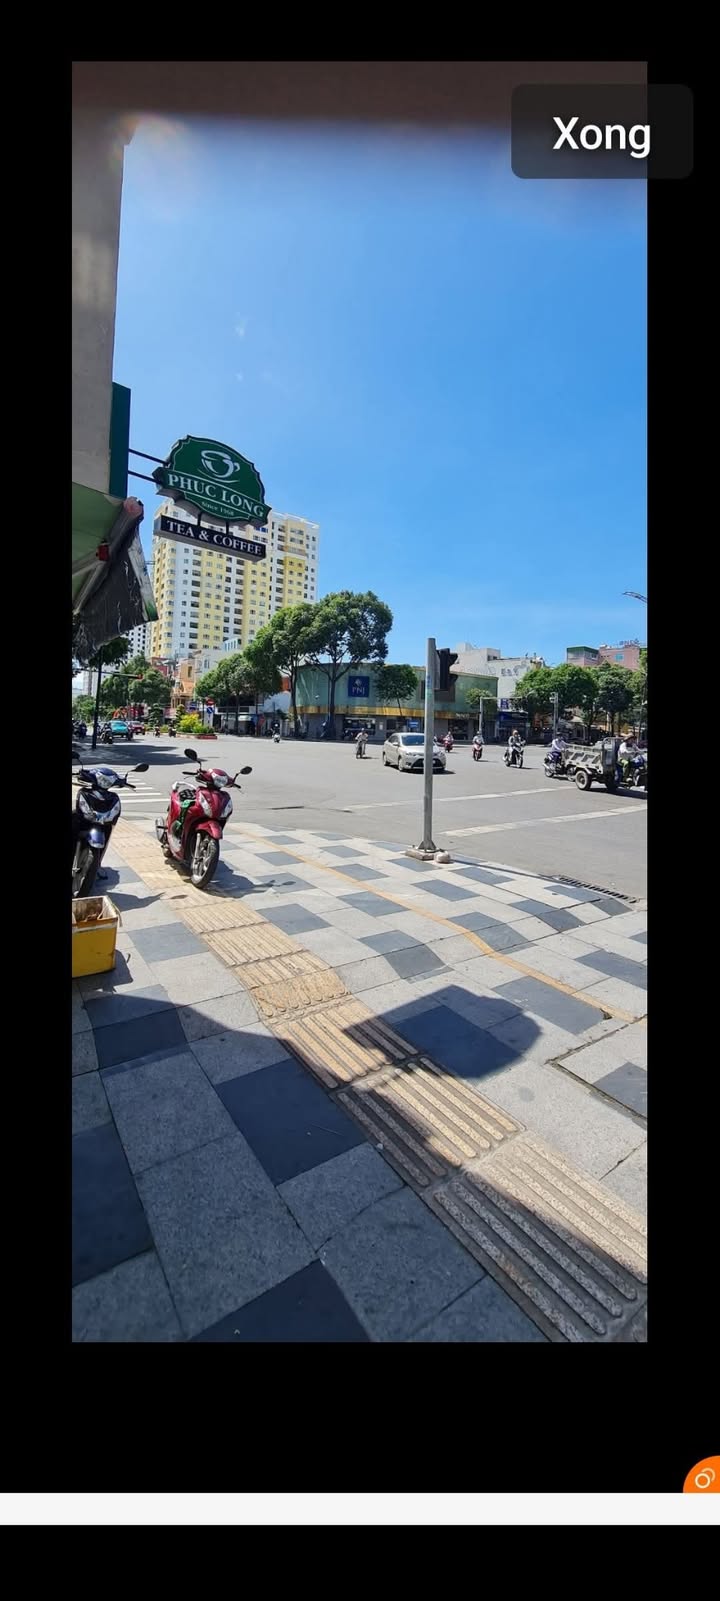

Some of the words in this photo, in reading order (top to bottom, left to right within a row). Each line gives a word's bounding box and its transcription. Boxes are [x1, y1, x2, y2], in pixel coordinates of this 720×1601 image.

[167, 473, 217, 499] PHUC
[221, 490, 264, 517] LONG
[166, 520, 195, 538] TEA
[198, 530, 209, 542] &
[213, 533, 262, 556] COFFEE
[351, 686, 366, 696] PNJ
